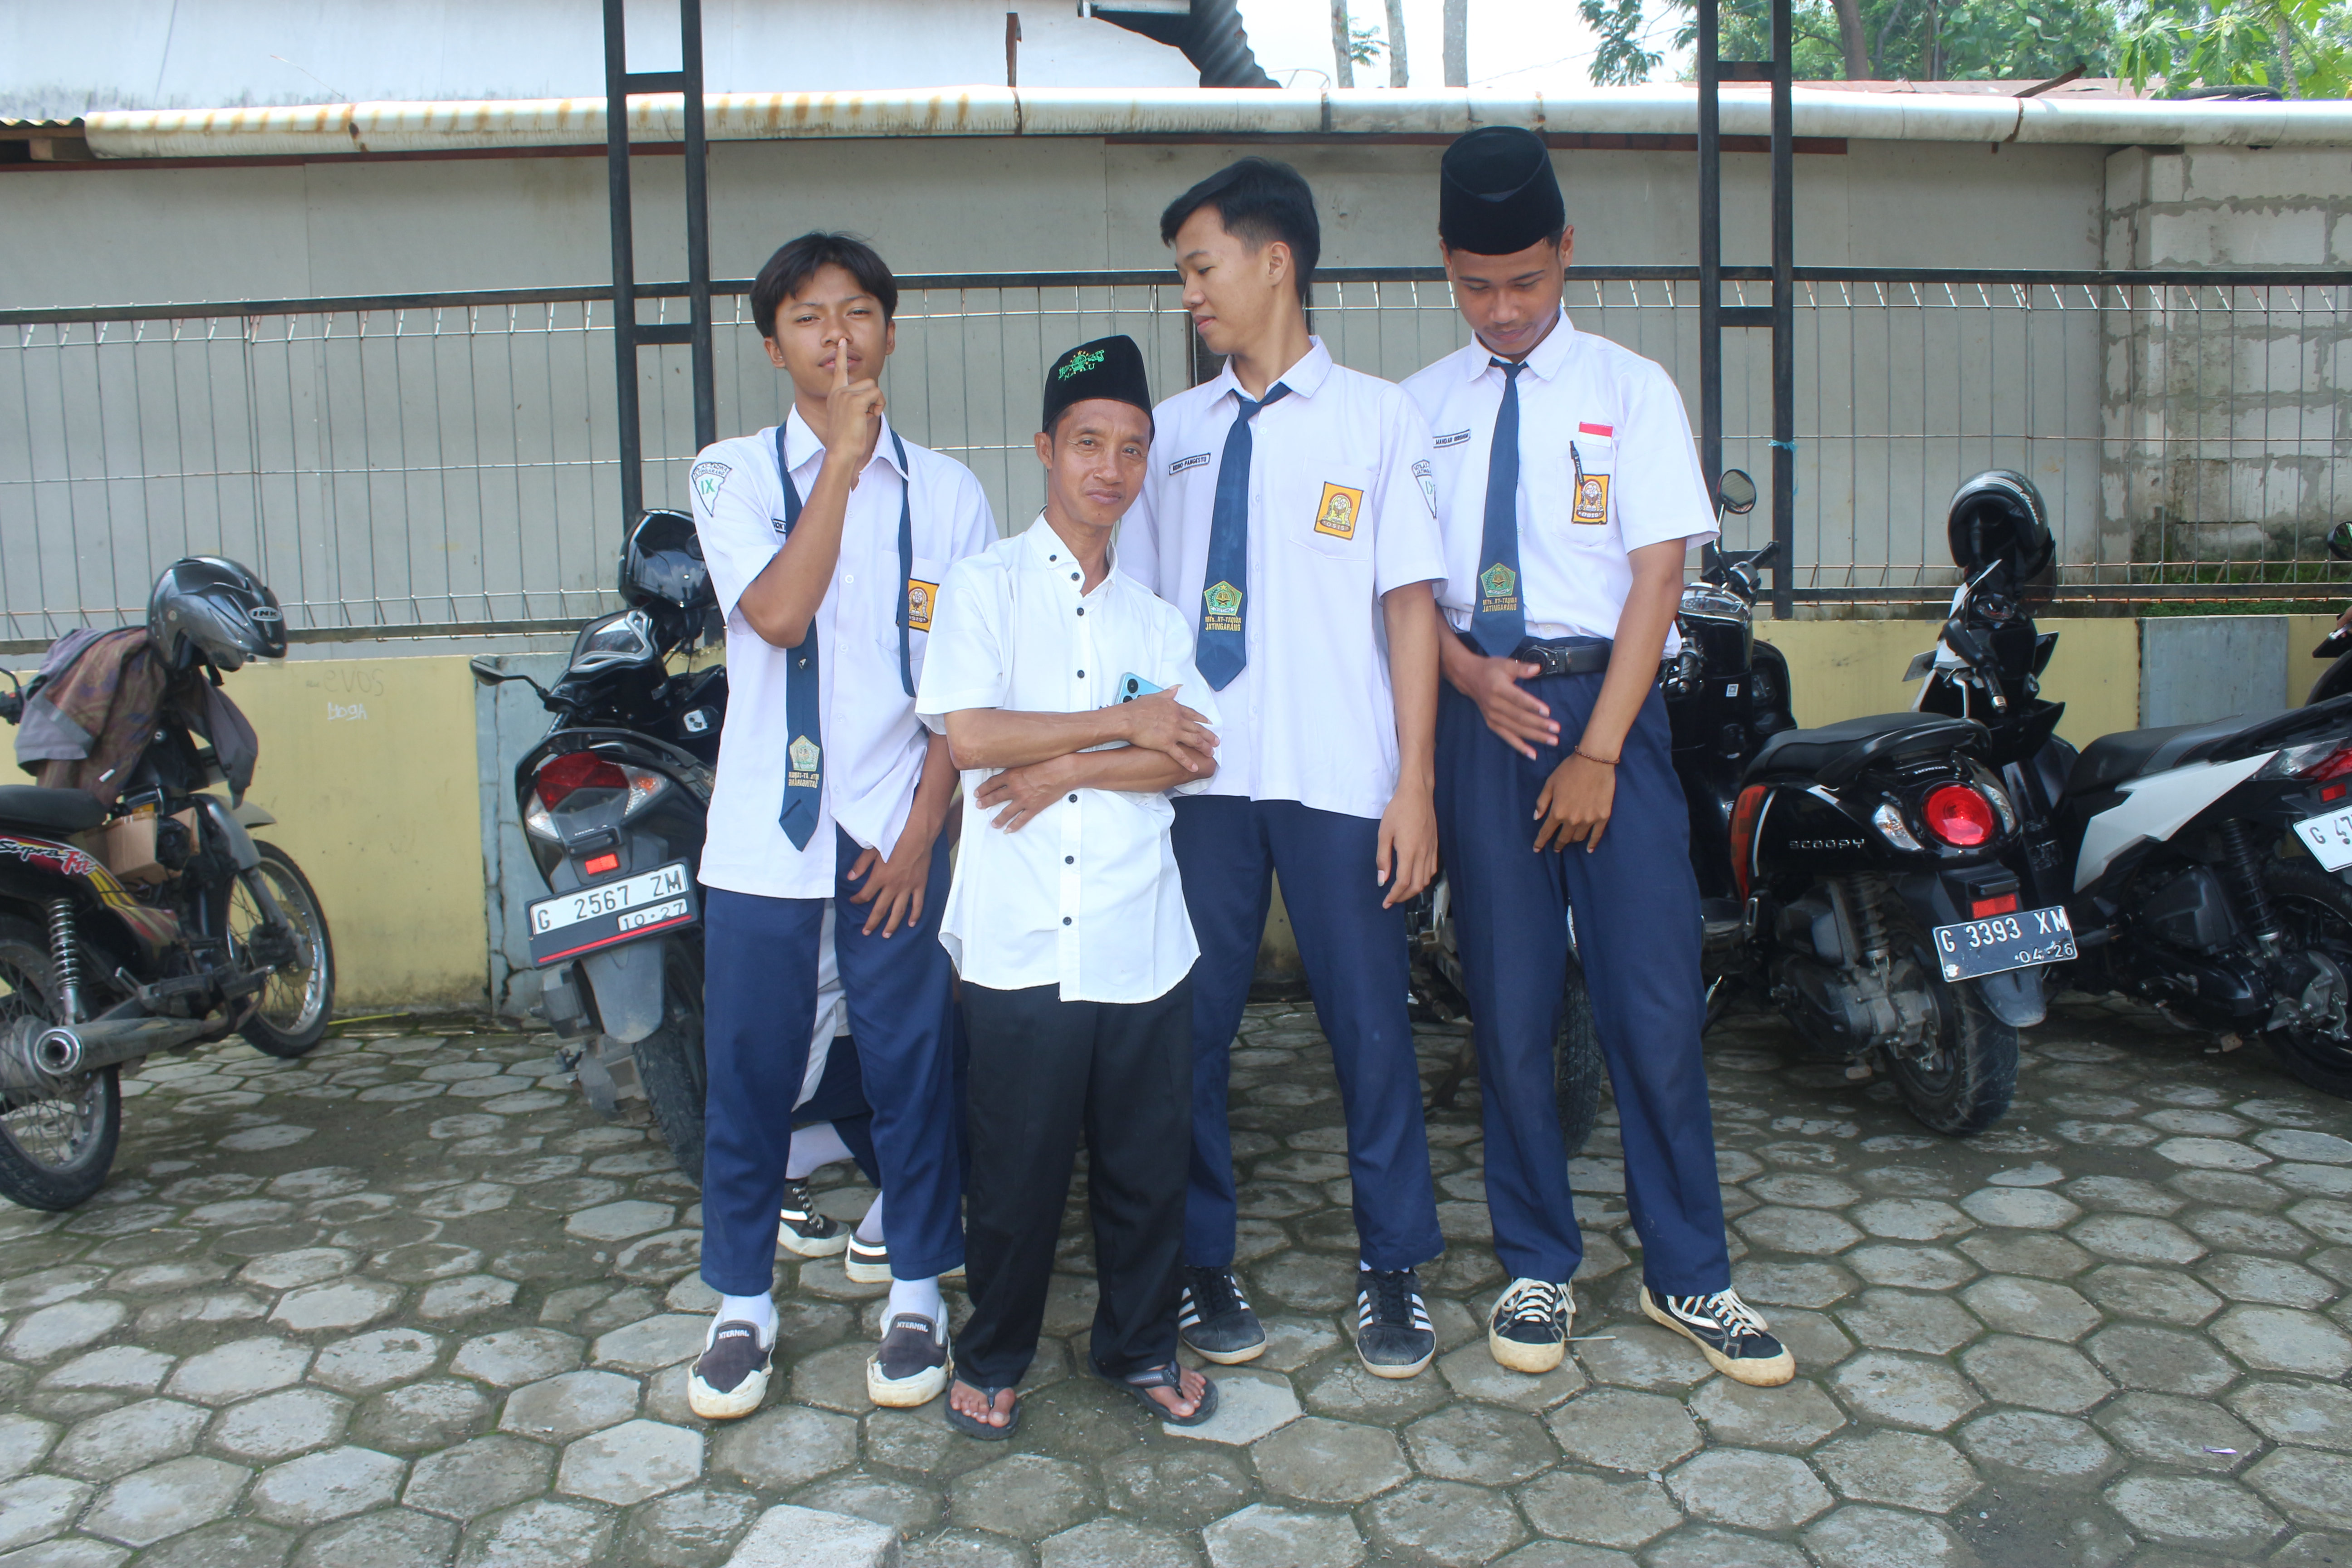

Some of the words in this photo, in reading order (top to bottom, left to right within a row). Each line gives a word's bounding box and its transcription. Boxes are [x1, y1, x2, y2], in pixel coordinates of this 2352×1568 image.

[1184, 456, 1207, 467] PANGESTU
[701, 478, 715, 495] IX
[1326, 521, 1345, 530] OSIS
[1482, 604, 1517, 612] JATINGARANG
[1205, 623, 1241, 631] JATINGARANG
[1913, 766, 1949, 774] HONDA
[573, 824, 608, 836] HONA
[2309, 826, 2326, 844] G
[1789, 838, 1865, 849] SCOOPY
[537, 909, 550, 930] G
[574, 885, 629, 920] 2567
[650, 870, 682, 897] ZM
[1940, 929, 1956, 953] G
[1965, 916, 2022, 948] 3393
[2034, 907, 2070, 935] XM
[896, 1321, 929, 1333] XTERNAL
[718, 1329, 750, 1340] XTERNAL
